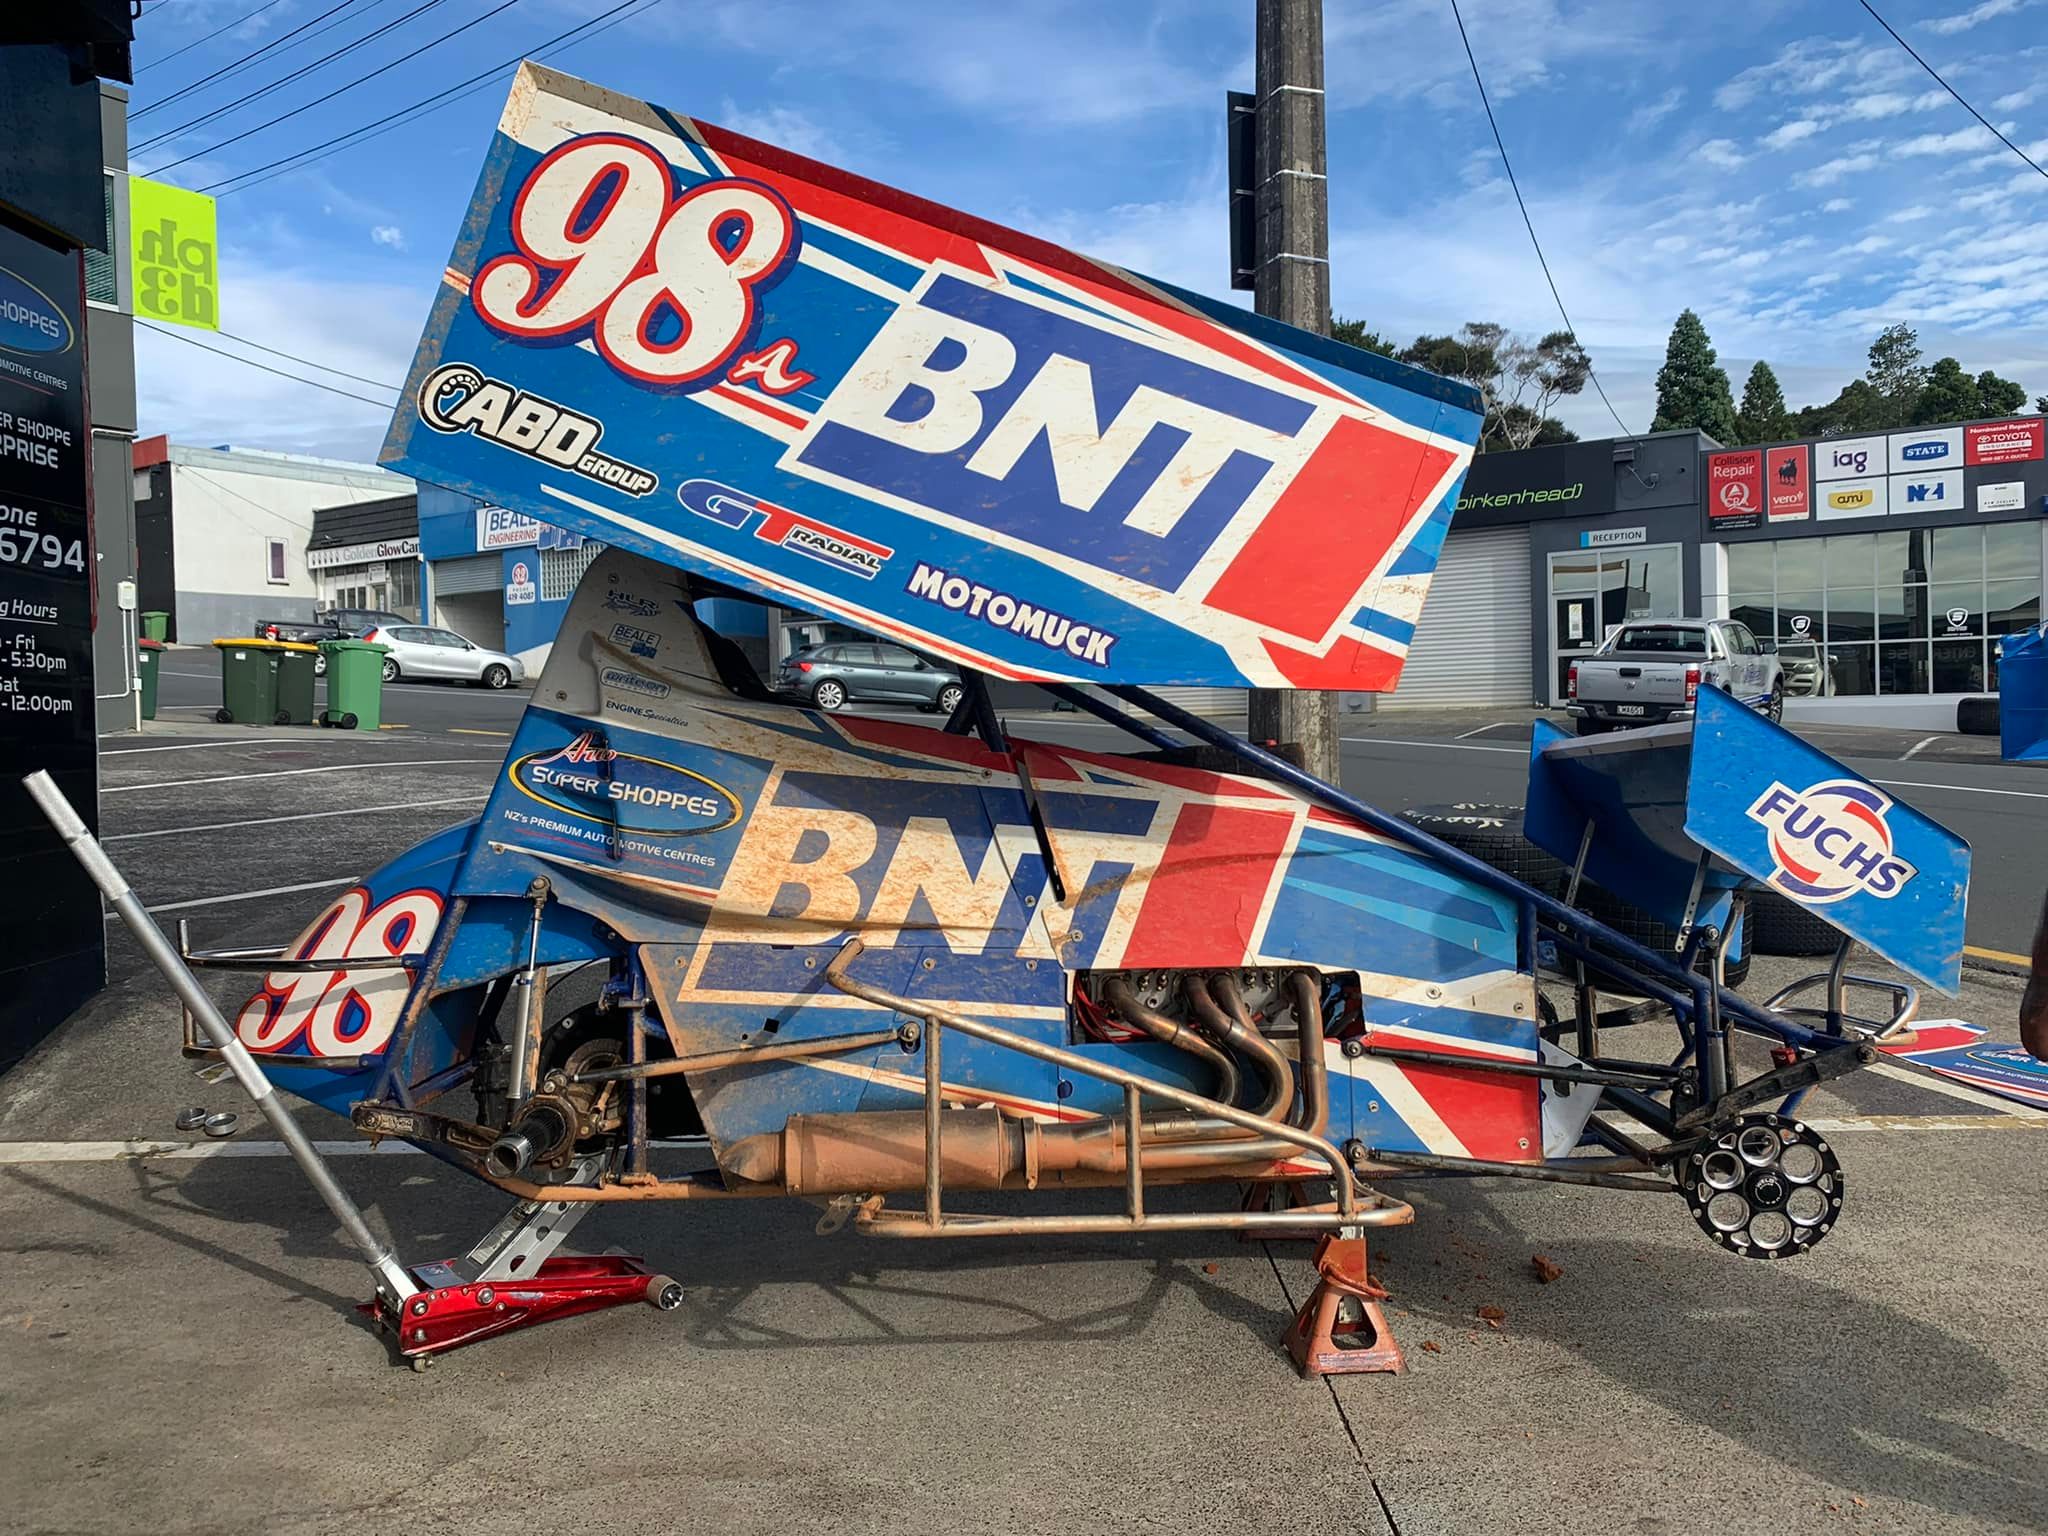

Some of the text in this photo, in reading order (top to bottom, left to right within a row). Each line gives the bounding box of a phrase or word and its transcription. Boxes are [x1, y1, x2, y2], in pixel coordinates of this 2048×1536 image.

[471, 133, 801, 392] 98
[33, 370, 68, 390] CENTRES
[838, 298, 1297, 538] BNT
[17, 417, 71, 447] SHOPPE
[1992, 431, 2031, 441] TOYOTA
[1713, 455, 1755, 467] Collision
[1906, 445, 1945, 457] STATE
[577, 454, 653, 491] GROUP
[1713, 464, 1755, 479] Repair
[1833, 451, 1867, 473] iag
[1772, 493, 1797, 505] vero
[1837, 492, 1864, 504] ami
[677, 479, 895, 560] GT
[488, 528, 537, 545] ENGINEERING
[1592, 530, 1642, 543] RECEPTION
[0, 527, 84, 573] 6794
[377, 543, 400, 558] Glow
[790, 528, 881, 571] RADIAL
[12, 599, 58, 619] Hours
[907, 563, 1115, 665] MOTOMUCK
[15, 634, 36, 650] Fri
[615, 625, 657, 645] BEALE
[11, 651, 67, 672] 5:30pm
[11, 695, 73, 714] 12:00pm
[606, 700, 689, 727] ENGINE Specialties
[531, 765, 720, 818] SUPER SHOPPES
[504, 809, 528, 824] NZ's
[530, 816, 582, 837] PREMIUM
[662, 848, 717, 867] CENTRES
[1755, 788, 1908, 893] FUCHS
[721, 803, 1149, 957] BNT
[235, 884, 446, 1057] 98
